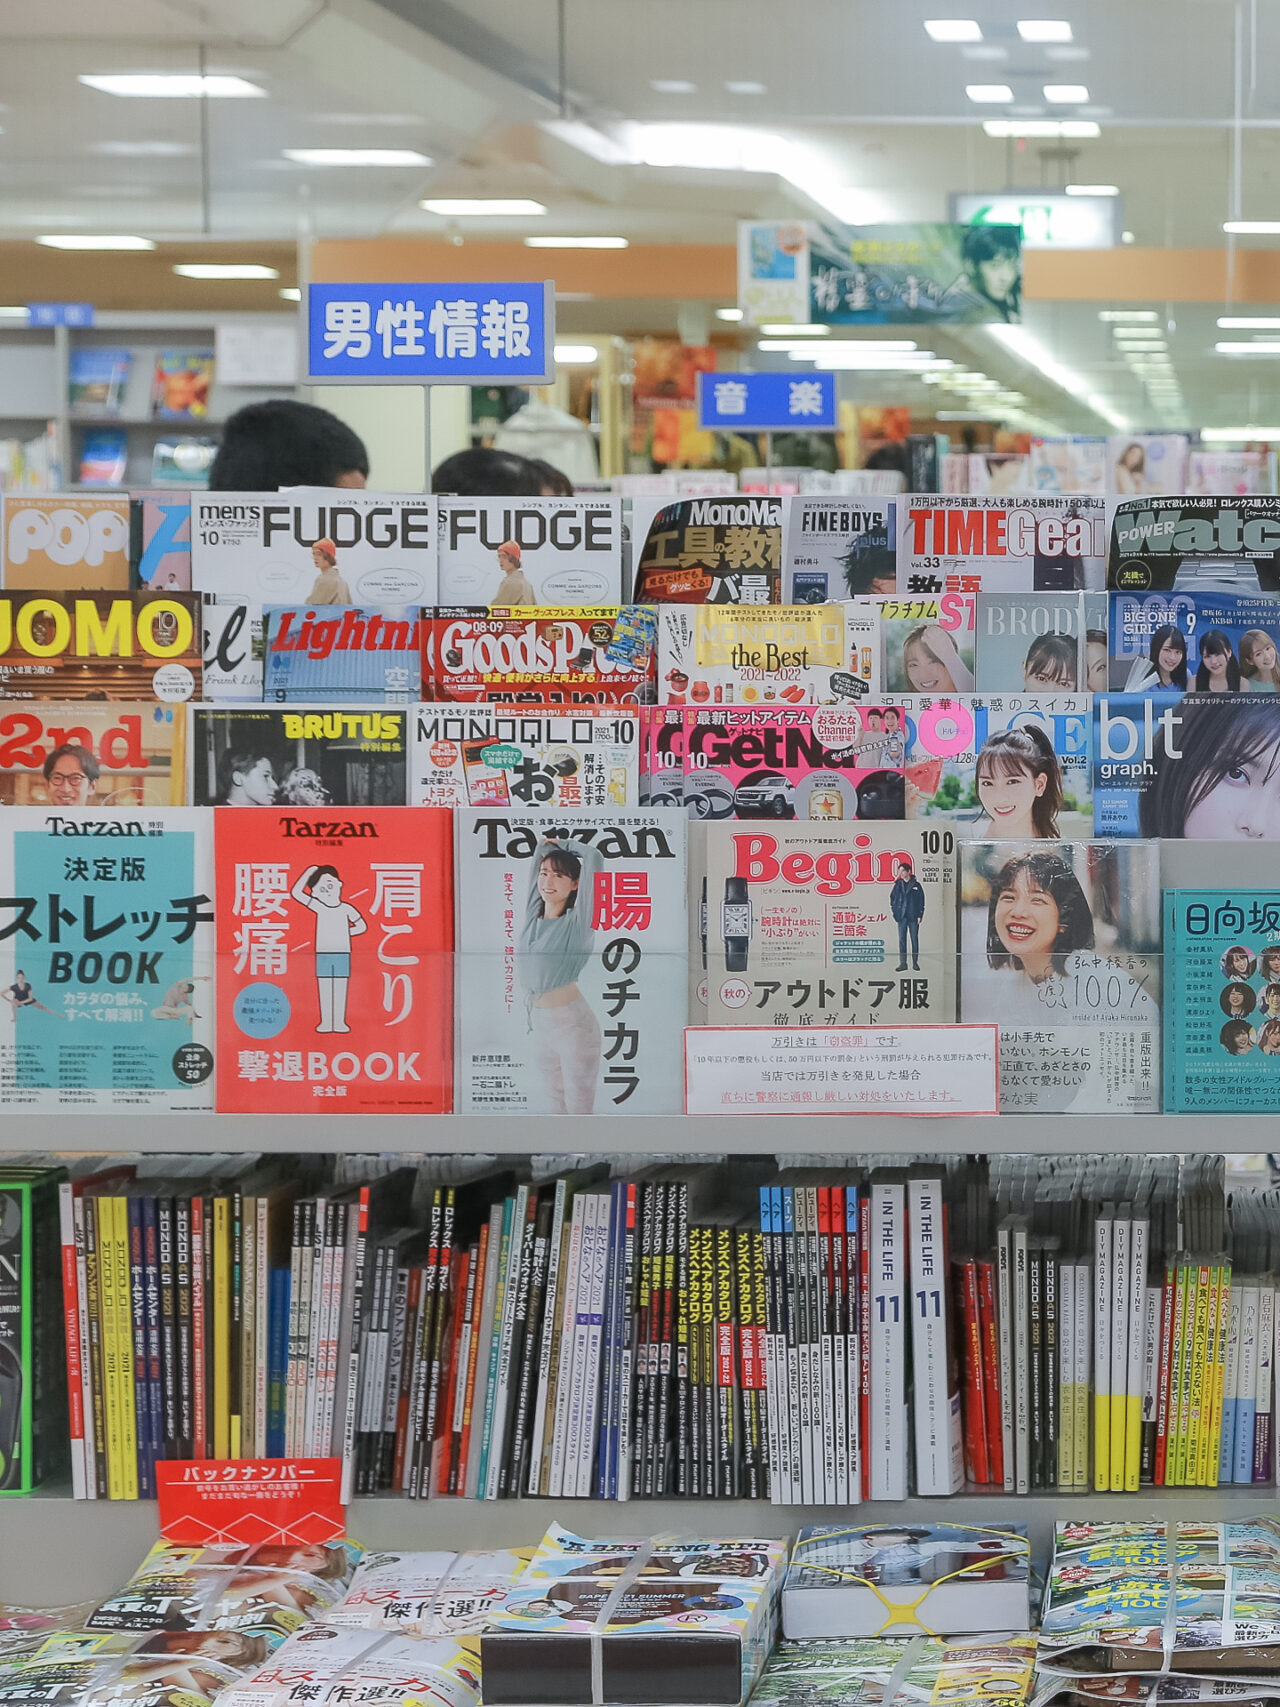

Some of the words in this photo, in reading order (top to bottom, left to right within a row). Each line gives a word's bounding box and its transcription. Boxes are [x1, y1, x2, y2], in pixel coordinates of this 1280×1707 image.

[323, 299, 532, 360] 男性情報
[200, 505, 260, 519] men's
[263, 505, 429, 549] FUDGE
[450, 510, 612, 551] FUDGE
[802, 511, 884, 533] FINEBOYS
[1118, 521, 1175, 543] POWER
[200, 532, 219, 545] 10
[911, 557, 941, 569] Vol.33
[1123, 612, 1144, 622] BIG
[1147, 612, 1176, 622] ONE
[1123, 622, 1163, 634] GIRLS
[0, 599, 193, 658] OMO
[731, 644, 761, 670] the
[766, 643, 810, 672] Best
[741, 669, 800, 681] 2021~2022
[282, 712, 402, 740] BRUTUS
[697, 711, 811, 726] 最新ヒットアイテム
[817, 715, 857, 725] おるたな
[1101, 698, 1183, 761] blt
[0, 712, 149, 770] 2nd
[417, 718, 593, 748] MONOQLO
[609, 720, 635, 744] 10
[817, 725, 856, 735] Channel
[1061, 756, 1087, 765] Vol.2
[1100, 761, 1158, 779] graph.
[45, 816, 146, 836] Tarzan
[279, 817, 379, 838] Tarzan
[510, 818, 659, 826] 決定版・食事とエクササイズで、腸を整える!
[64, 857, 146, 882] 決定版
[730, 832, 915, 897] Begin
[0, 894, 214, 944] ストレッチ
[232, 863, 291, 976] 腰痛
[761, 916, 821, 927] 腕時計は絶対に
[832, 912, 888, 923] 通勤シェル
[833, 925, 868, 937] 三箇条
[369, 863, 424, 1026] 肩こり
[48, 952, 164, 984] BOOK
[590, 871, 652, 1105] 腸のチカラ
[724, 988, 745, 999] 秋の
[754, 978, 930, 1009] アウトドア服
[64, 1008, 143, 1022] すべて解消!!
[237, 1051, 421, 1082] 撃退BOOK
[761, 1070, 921, 1082] 当店では万引きを発見した場合
[313, 1085, 347, 1097] 完全版
[762, 1202, 769, 1218] ヘア
[882, 1201, 893, 1218] IN
[882, 1221, 893, 1247] THE
[689, 1228, 700, 1323] メンズヘアカタログ
[882, 1252, 893, 1281] LIFE
[1098, 1253, 1106, 1312] MAGAZINE
[875, 1295, 900, 1323] 11
[183, 1465, 315, 1481] バックナンバー
